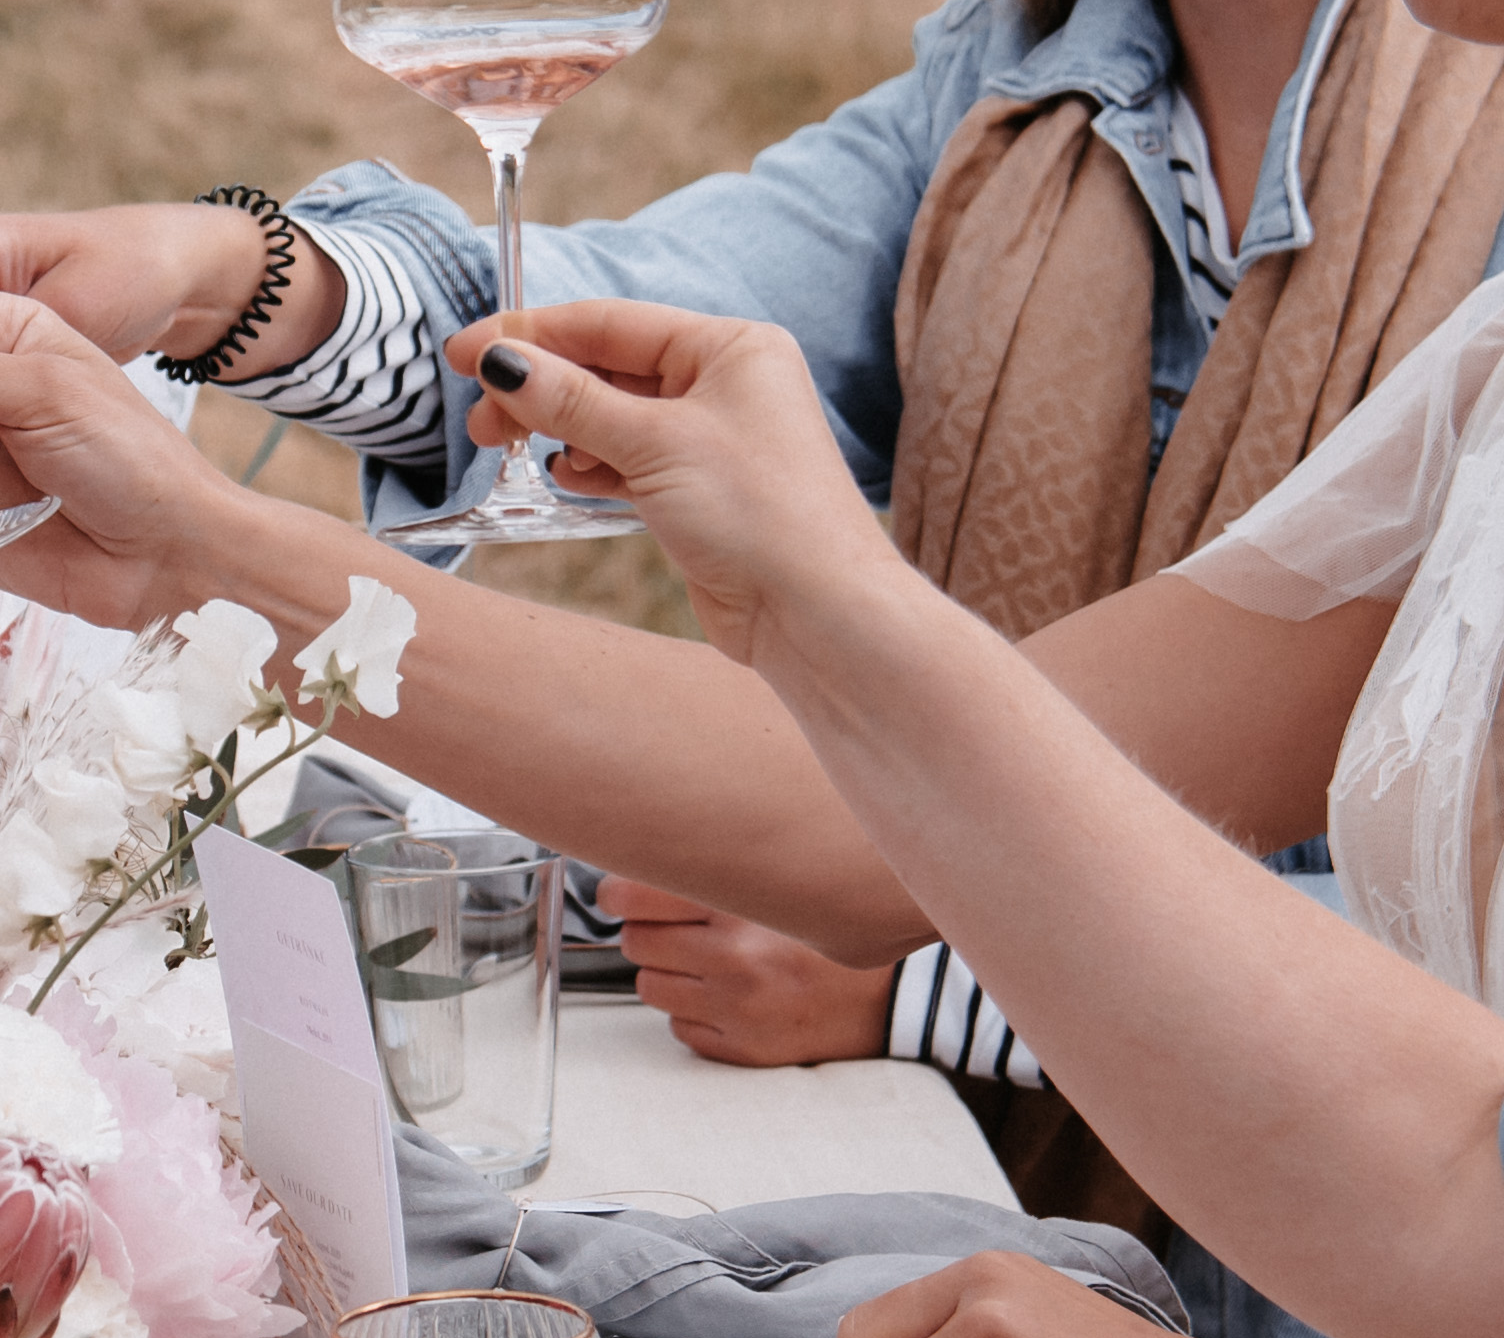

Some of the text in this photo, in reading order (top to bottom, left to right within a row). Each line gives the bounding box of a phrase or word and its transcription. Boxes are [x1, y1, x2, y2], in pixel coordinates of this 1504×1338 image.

[280, 1173, 354, 1224] SAVE OUR DATE
